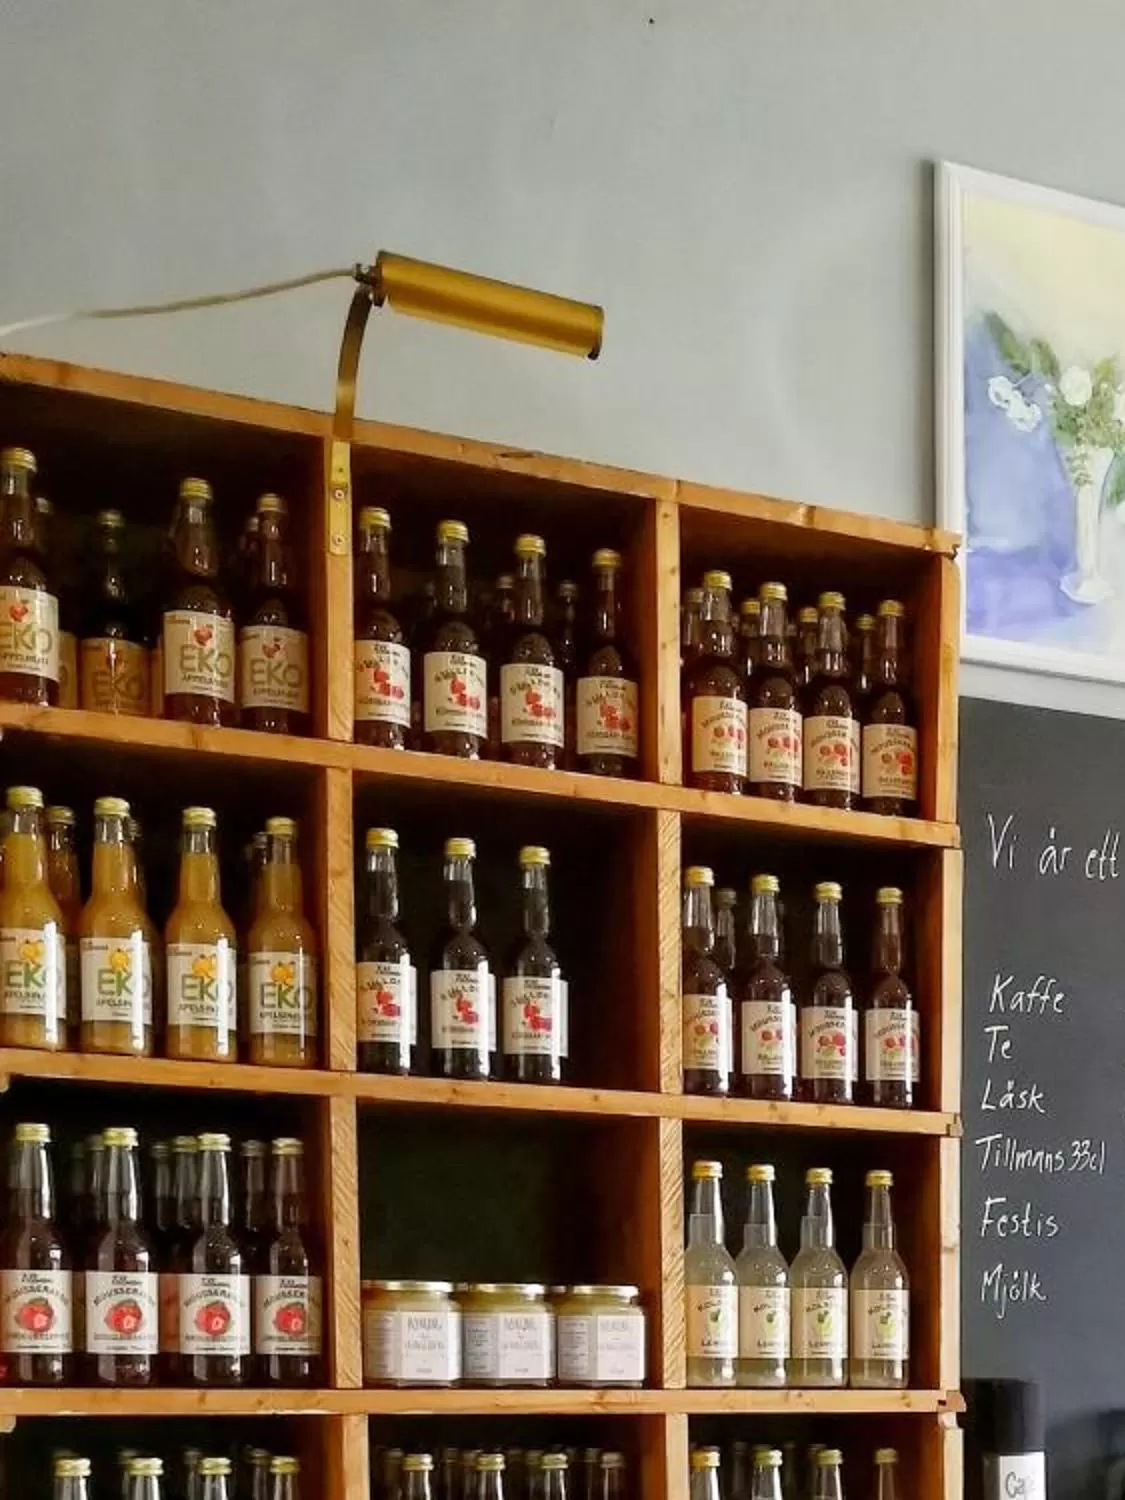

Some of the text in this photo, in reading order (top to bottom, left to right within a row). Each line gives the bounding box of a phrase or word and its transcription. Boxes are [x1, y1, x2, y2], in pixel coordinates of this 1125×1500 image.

[180, 644, 231, 677] EKO
[250, 658, 301, 688] EKO
[986, 813, 1019, 869] Vi
[1039, 827, 1072, 874] är
[1085, 830, 1121, 881] ett
[260, 981, 313, 1010] EKO
[989, 973, 1065, 1014] Kaffe
[984, 1025, 1013, 1063] Te
[981, 1078, 1047, 1114] Läsk
[975, 1133, 1065, 1174] Tillmans
[980, 1196, 1060, 1238] Festis
[981, 1263, 1047, 1320] Mjölk
